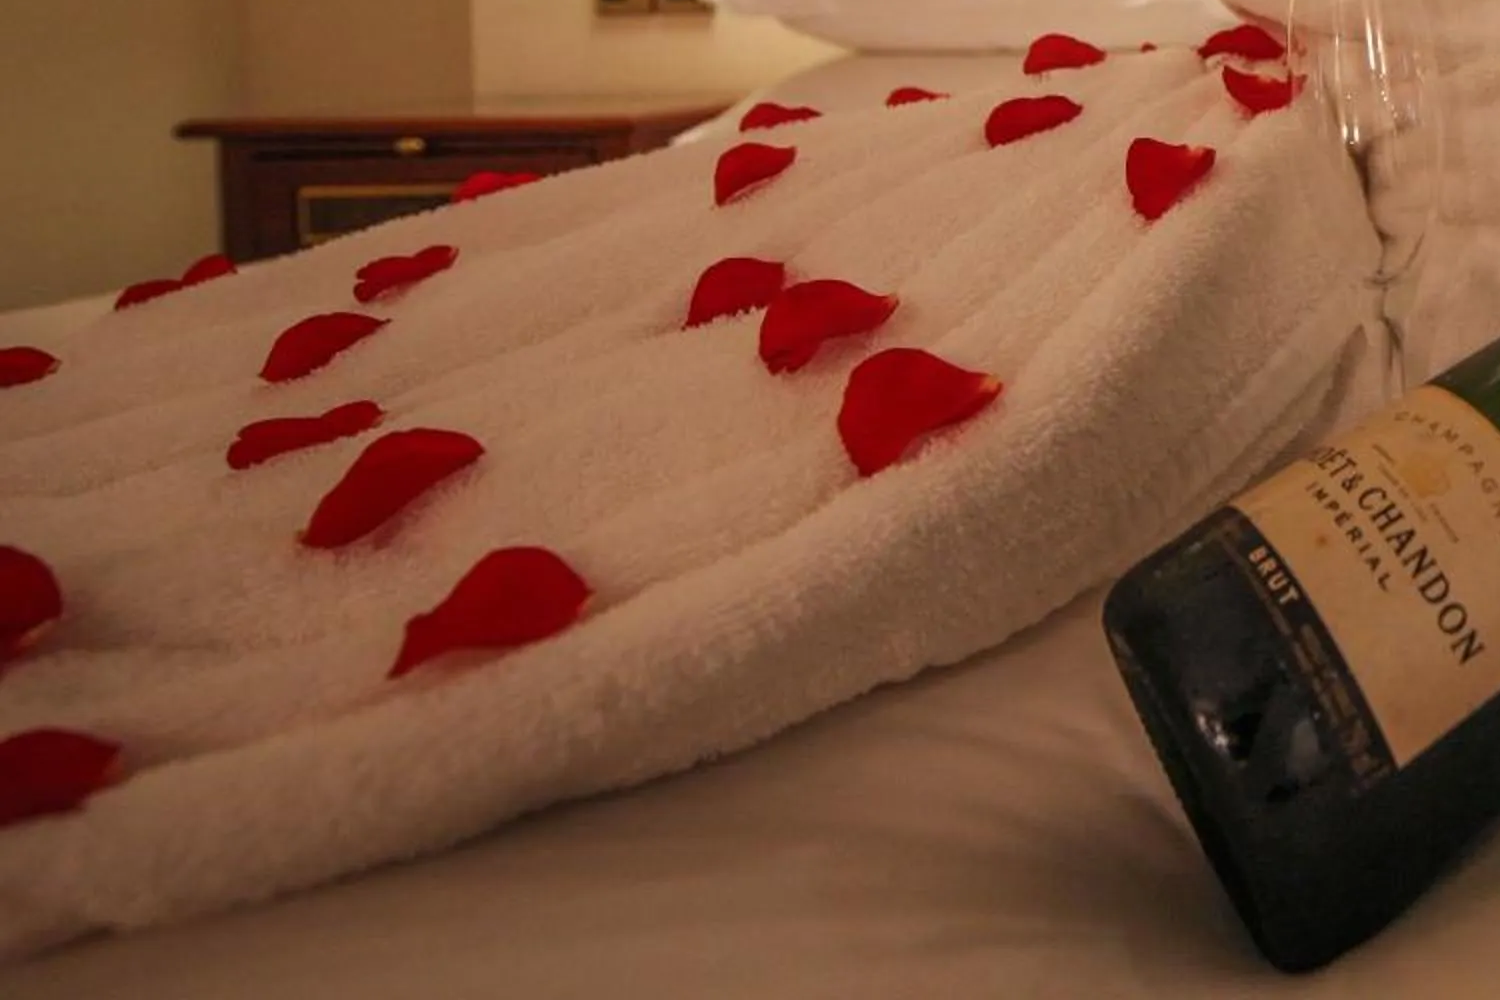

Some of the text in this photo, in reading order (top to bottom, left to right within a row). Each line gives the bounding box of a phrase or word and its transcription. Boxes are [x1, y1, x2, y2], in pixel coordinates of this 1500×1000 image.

[1248, 547, 1299, 605] BRUT
[1341, 473, 1365, 493] &
[1358, 487, 1486, 665] CHANDON
